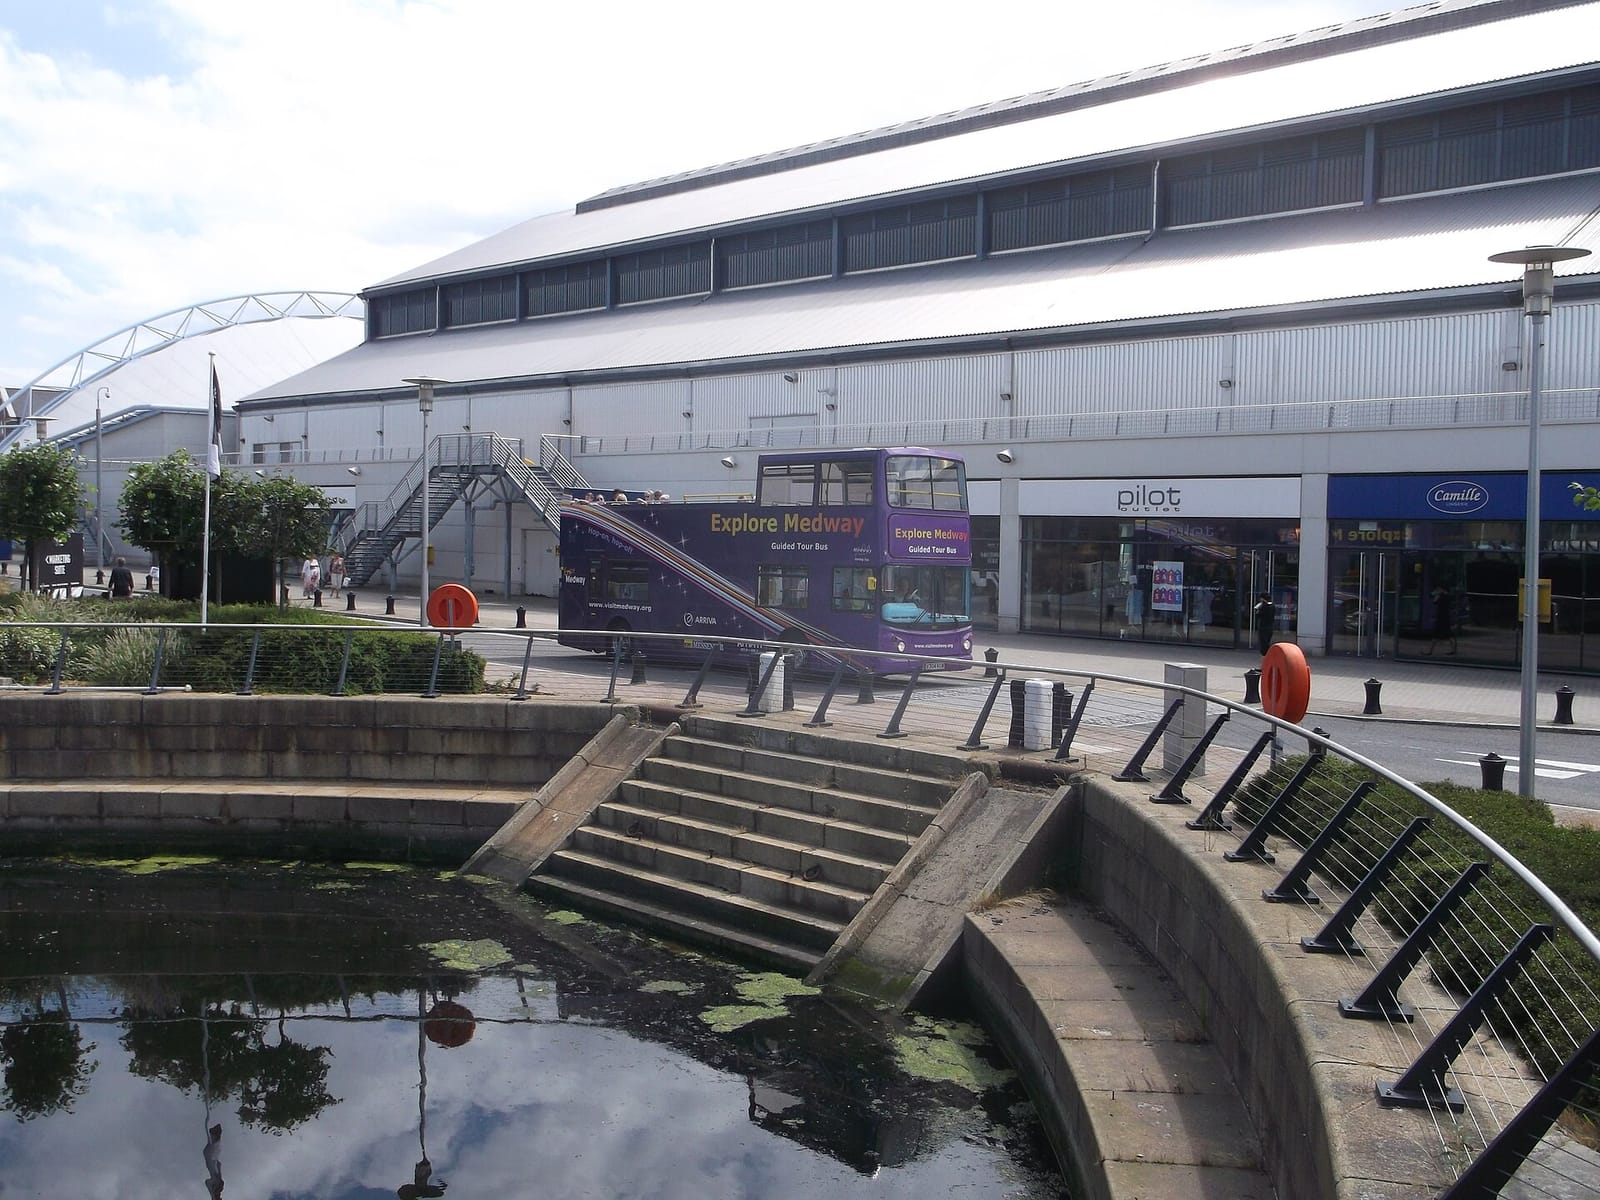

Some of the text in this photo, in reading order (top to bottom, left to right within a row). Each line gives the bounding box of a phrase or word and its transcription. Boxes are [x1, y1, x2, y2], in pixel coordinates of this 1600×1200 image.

[1118, 485, 1181, 510] pilot
[1434, 488, 1481, 501] Camille
[711, 513, 865, 538] Explore Medway
[895, 528, 968, 542] Explore Medway
[771, 542, 829, 551] Guided Tour Bus
[946, 546, 957, 554] Bus
[589, 602, 652, 613] www.visitmedway.org
[695, 616, 717, 625] ARRIVA
